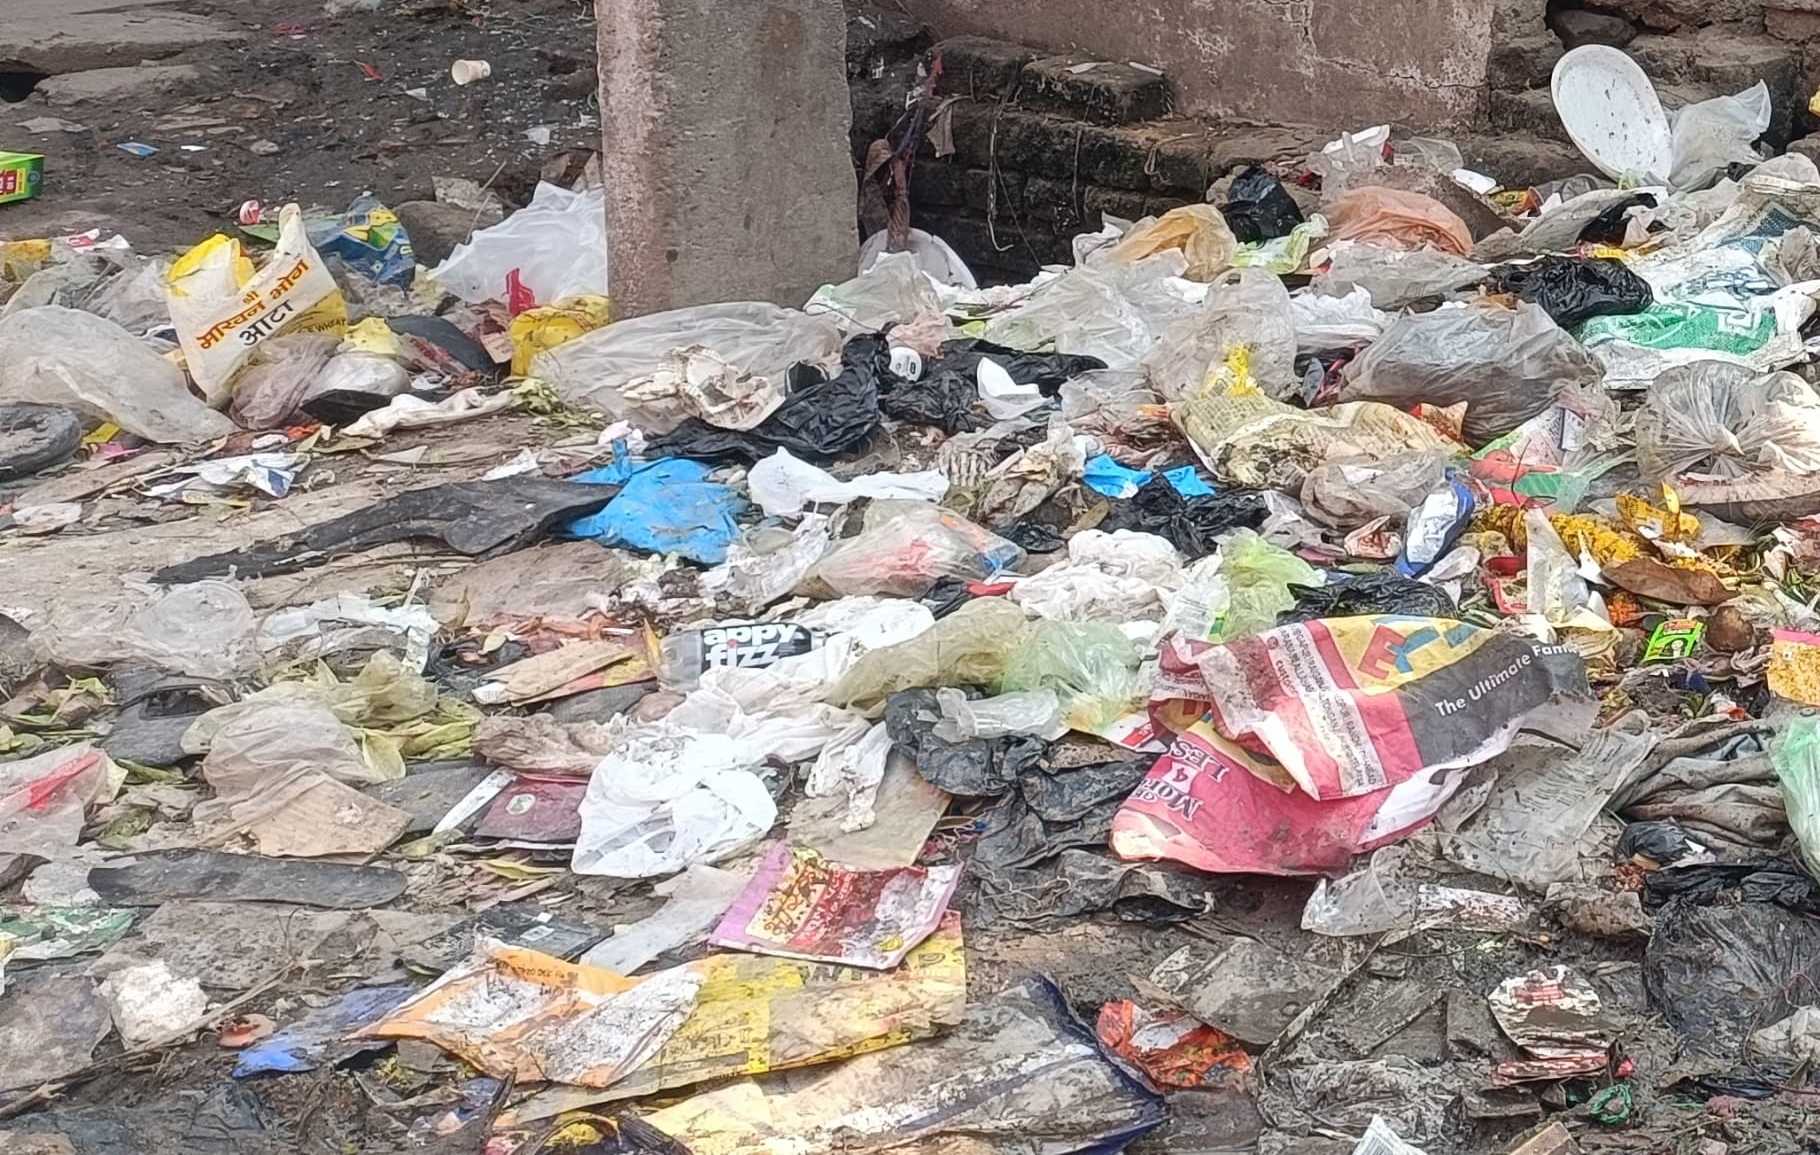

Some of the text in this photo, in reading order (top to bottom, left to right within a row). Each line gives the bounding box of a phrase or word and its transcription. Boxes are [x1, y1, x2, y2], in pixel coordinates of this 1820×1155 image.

[270, 258, 309, 300] भोग
[239, 299, 294, 347] आटा
[316, 318, 346, 332] WHEAT
[703, 624, 798, 646] appy
[705, 642, 780, 667] fizz
[1435, 697, 1467, 718] The
[1468, 654, 1532, 702] Ultimate
